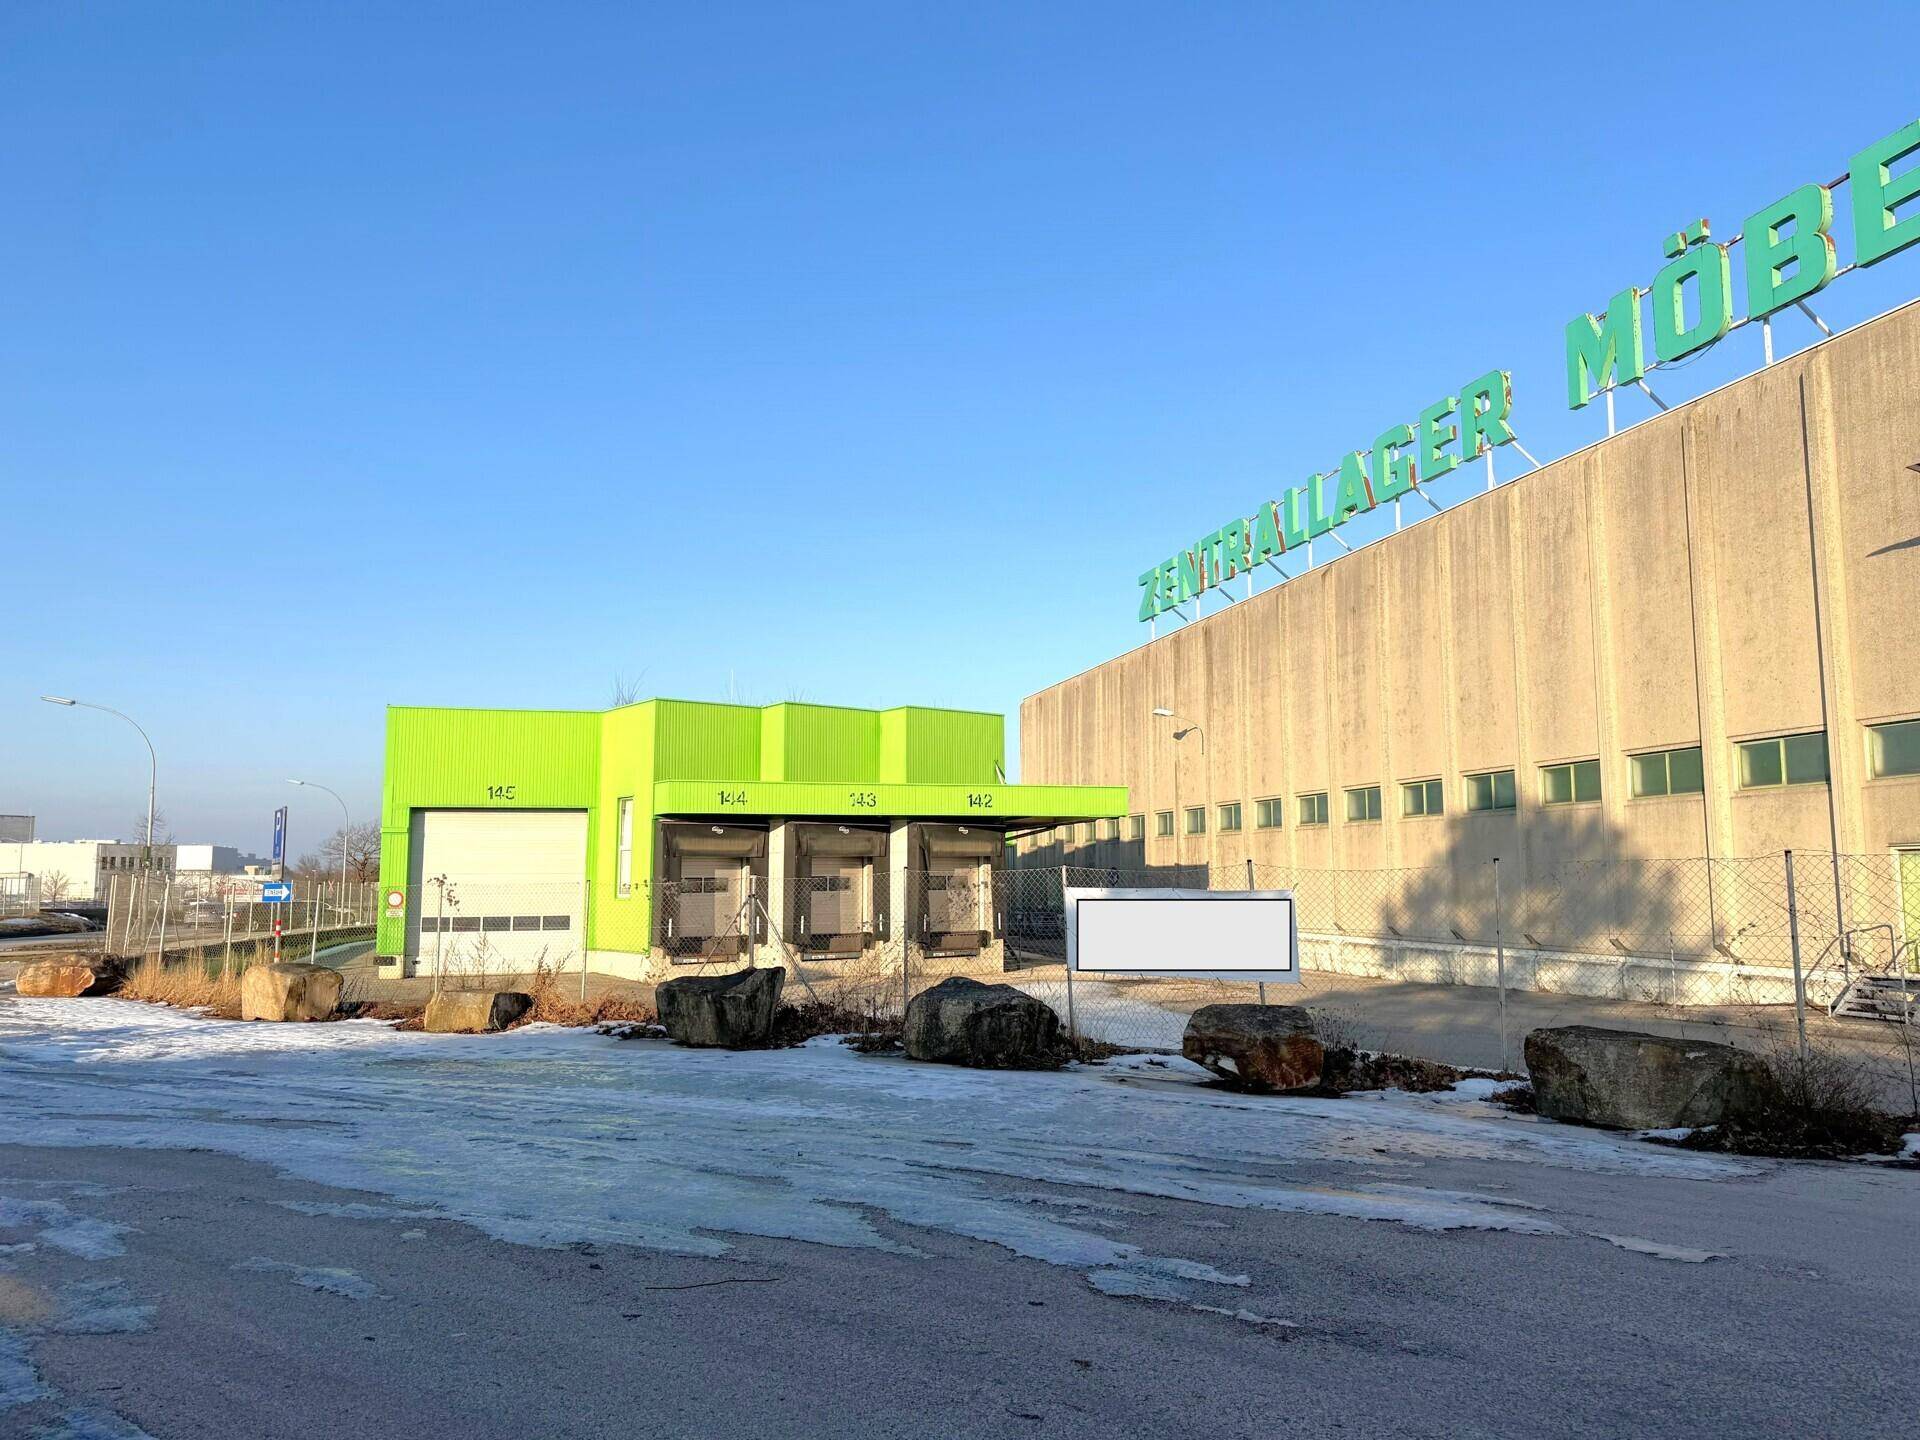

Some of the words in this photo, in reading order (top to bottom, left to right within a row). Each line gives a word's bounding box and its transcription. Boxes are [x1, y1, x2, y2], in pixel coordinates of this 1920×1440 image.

[1138, 369, 1517, 622] ZENTRALLAGER
[487, 785, 516, 800] 145
[718, 790, 748, 806] 144
[849, 792, 877, 808] 143
[966, 793, 993, 808] 142
